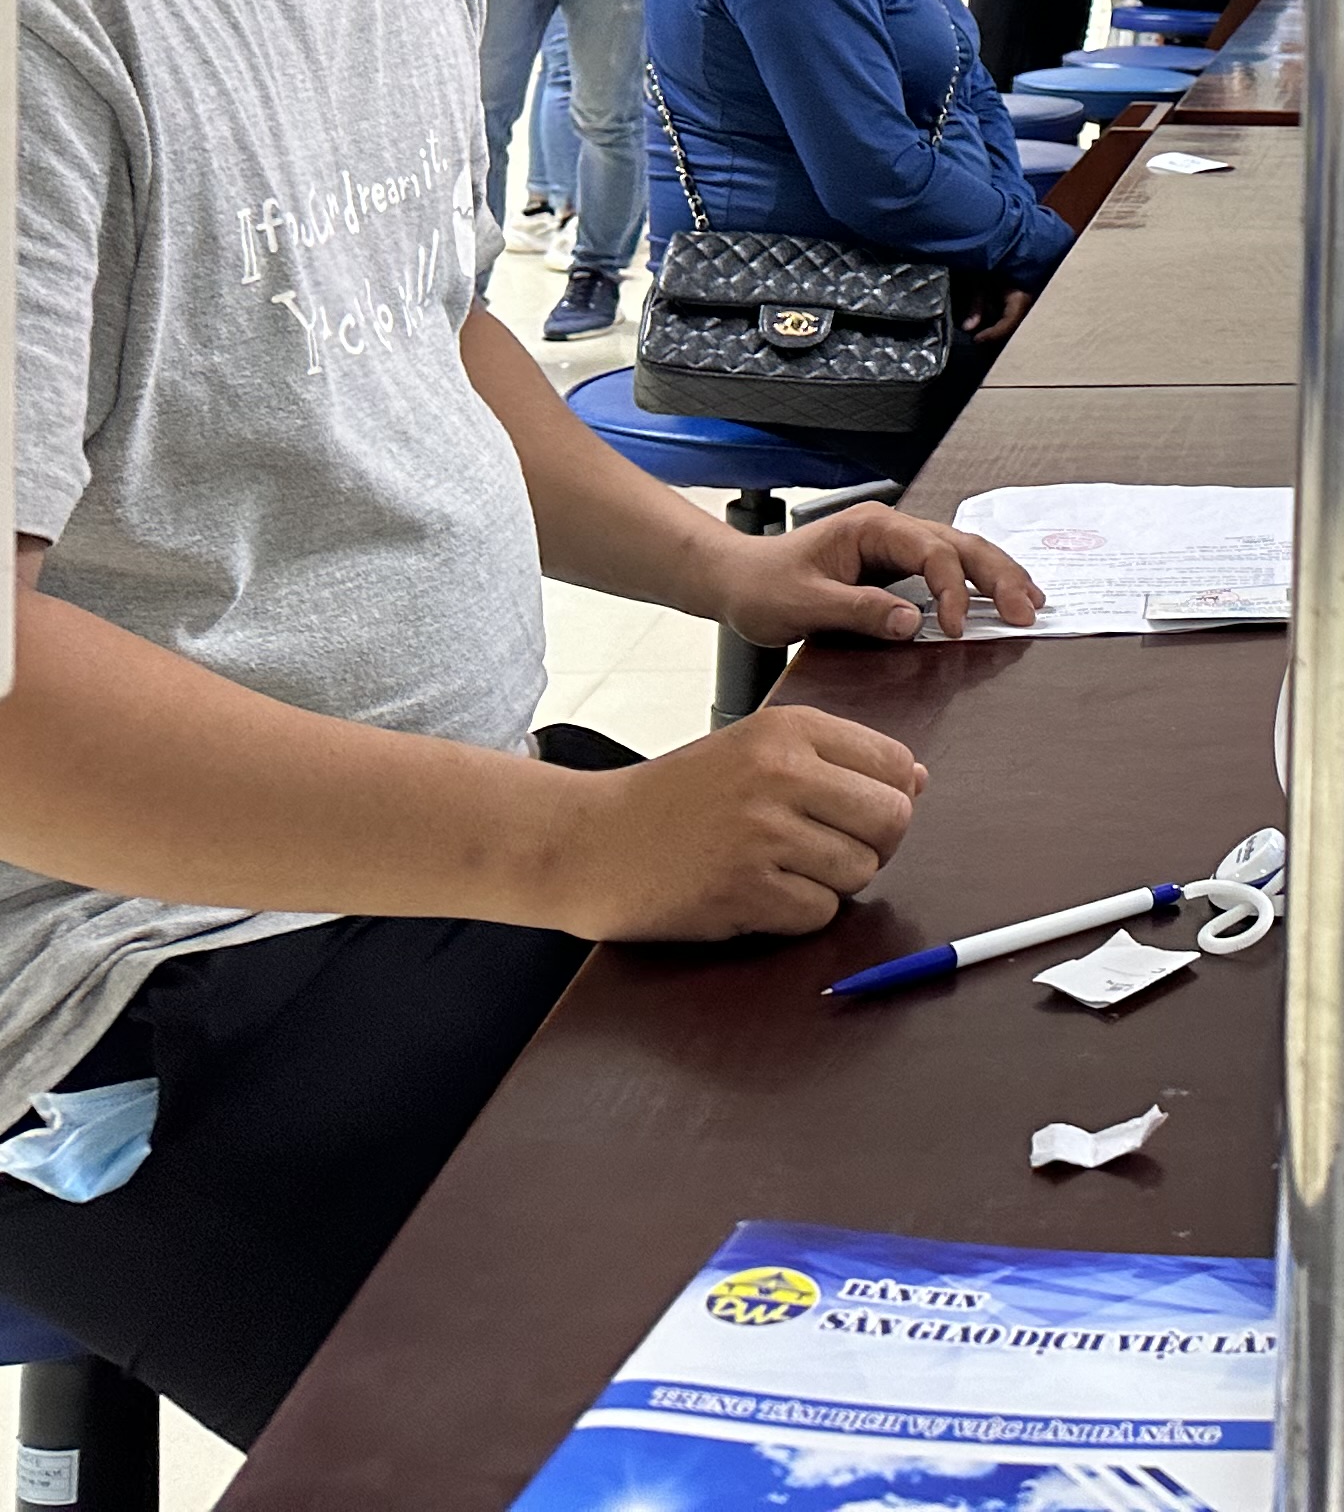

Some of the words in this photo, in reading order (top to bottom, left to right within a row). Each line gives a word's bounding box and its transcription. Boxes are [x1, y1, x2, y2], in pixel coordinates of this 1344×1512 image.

[925, 1291, 985, 1309] TIN
[820, 1308, 900, 1337] SÀN
[906, 1320, 1001, 1346] GIAO
[1010, 1329, 1104, 1356] DỊCH
[1118, 1330, 1204, 1360] VIỆC
[651, 1387, 757, 1417] TRUNG
[907, 1413, 951, 1438] VỤ
[952, 1416, 1023, 1444] VIỆC
[1139, 1419, 1223, 1445] NẴNG
